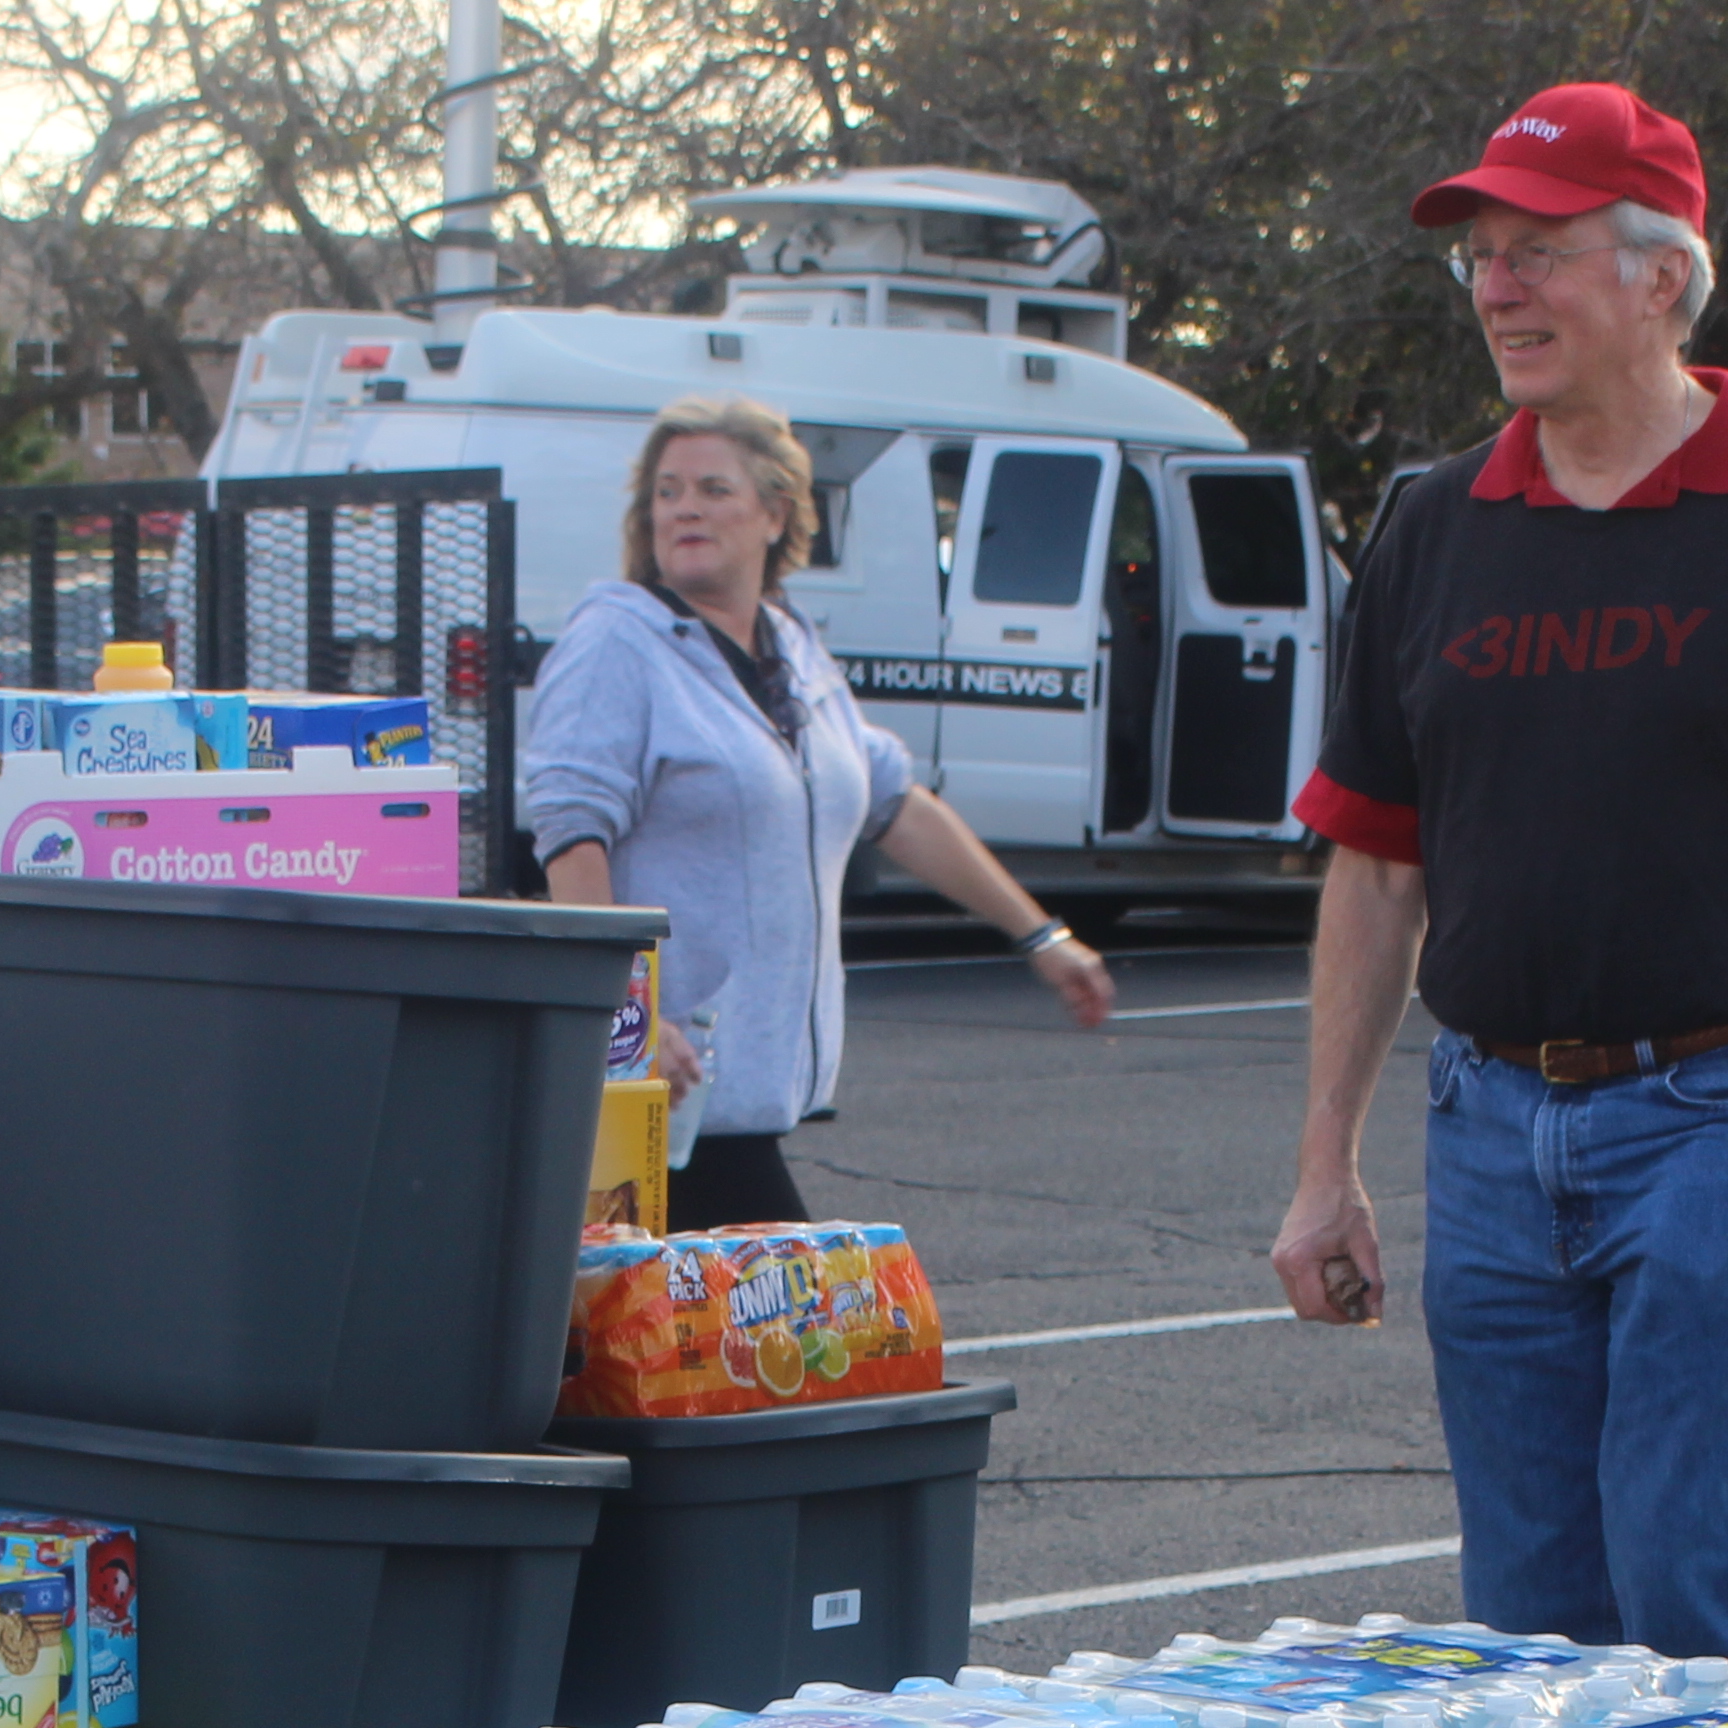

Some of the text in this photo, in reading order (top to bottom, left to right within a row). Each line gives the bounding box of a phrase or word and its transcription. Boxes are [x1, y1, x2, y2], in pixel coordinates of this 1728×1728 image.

[873, 661, 1064, 698] HOUR NEWS
[109, 723, 149, 754] Sea
[77, 747, 186, 774] Creatures
[110, 840, 361, 885] Cotton Candy
[667, 1281, 707, 1301] PACK
